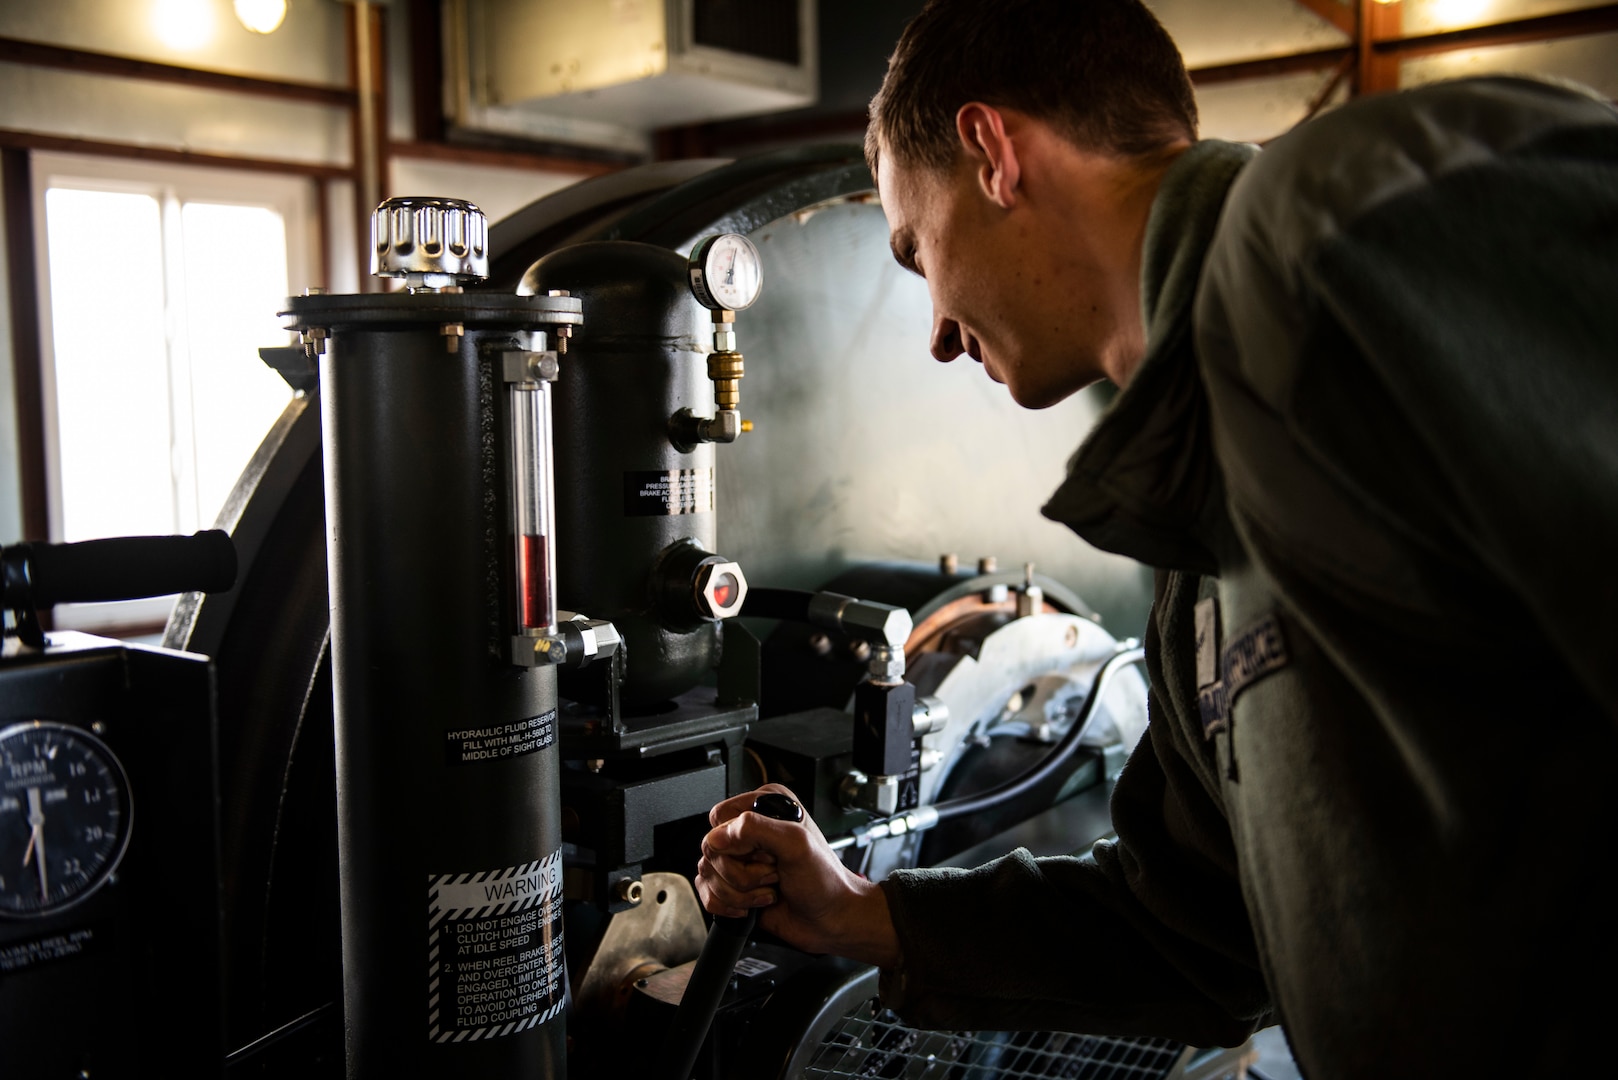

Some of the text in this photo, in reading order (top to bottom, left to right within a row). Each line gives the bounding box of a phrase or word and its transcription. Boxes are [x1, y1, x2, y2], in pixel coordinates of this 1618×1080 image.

[448, 710, 556, 740] HYDRAULIC FLUID RESERVOIR
[463, 724, 552, 750] FILL WITH MIL-H-5606 TO
[462, 734, 552, 761] MIDDLE OF SIGHT GLASS
[10, 759, 48, 778] RPM
[69, 762, 87, 777] 16
[84, 826, 103, 842] 20
[64, 857, 80, 875] 22
[484, 868, 556, 901] WARNING
[444, 924, 453, 934] 1.
[456, 922, 474, 934] DO
[476, 920, 498, 932] NOT
[500, 910, 537, 928] ENGAGE
[457, 931, 500, 944] CLUTCH
[502, 921, 537, 938] UNLESS
[538, 910, 558, 928] ENGINE
[444, 964, 454, 973] 2.
[457, 960, 491, 972] WHEN
[492, 954, 518, 968] REEL
[520, 943, 549, 962] BRAKES
[457, 934, 530, 956] AT IDLE SPEED
[457, 959, 558, 994] ENGAGED, LIMIT ENGINE
[458, 944, 562, 984] AND OVERCENTER CLUTCH
[457, 963, 564, 1005] OPERATION TO ONE MINUTE
[458, 980, 558, 1016] TO AVOID OVERHEATING
[457, 1002, 538, 1027] FLUID COUPLING
